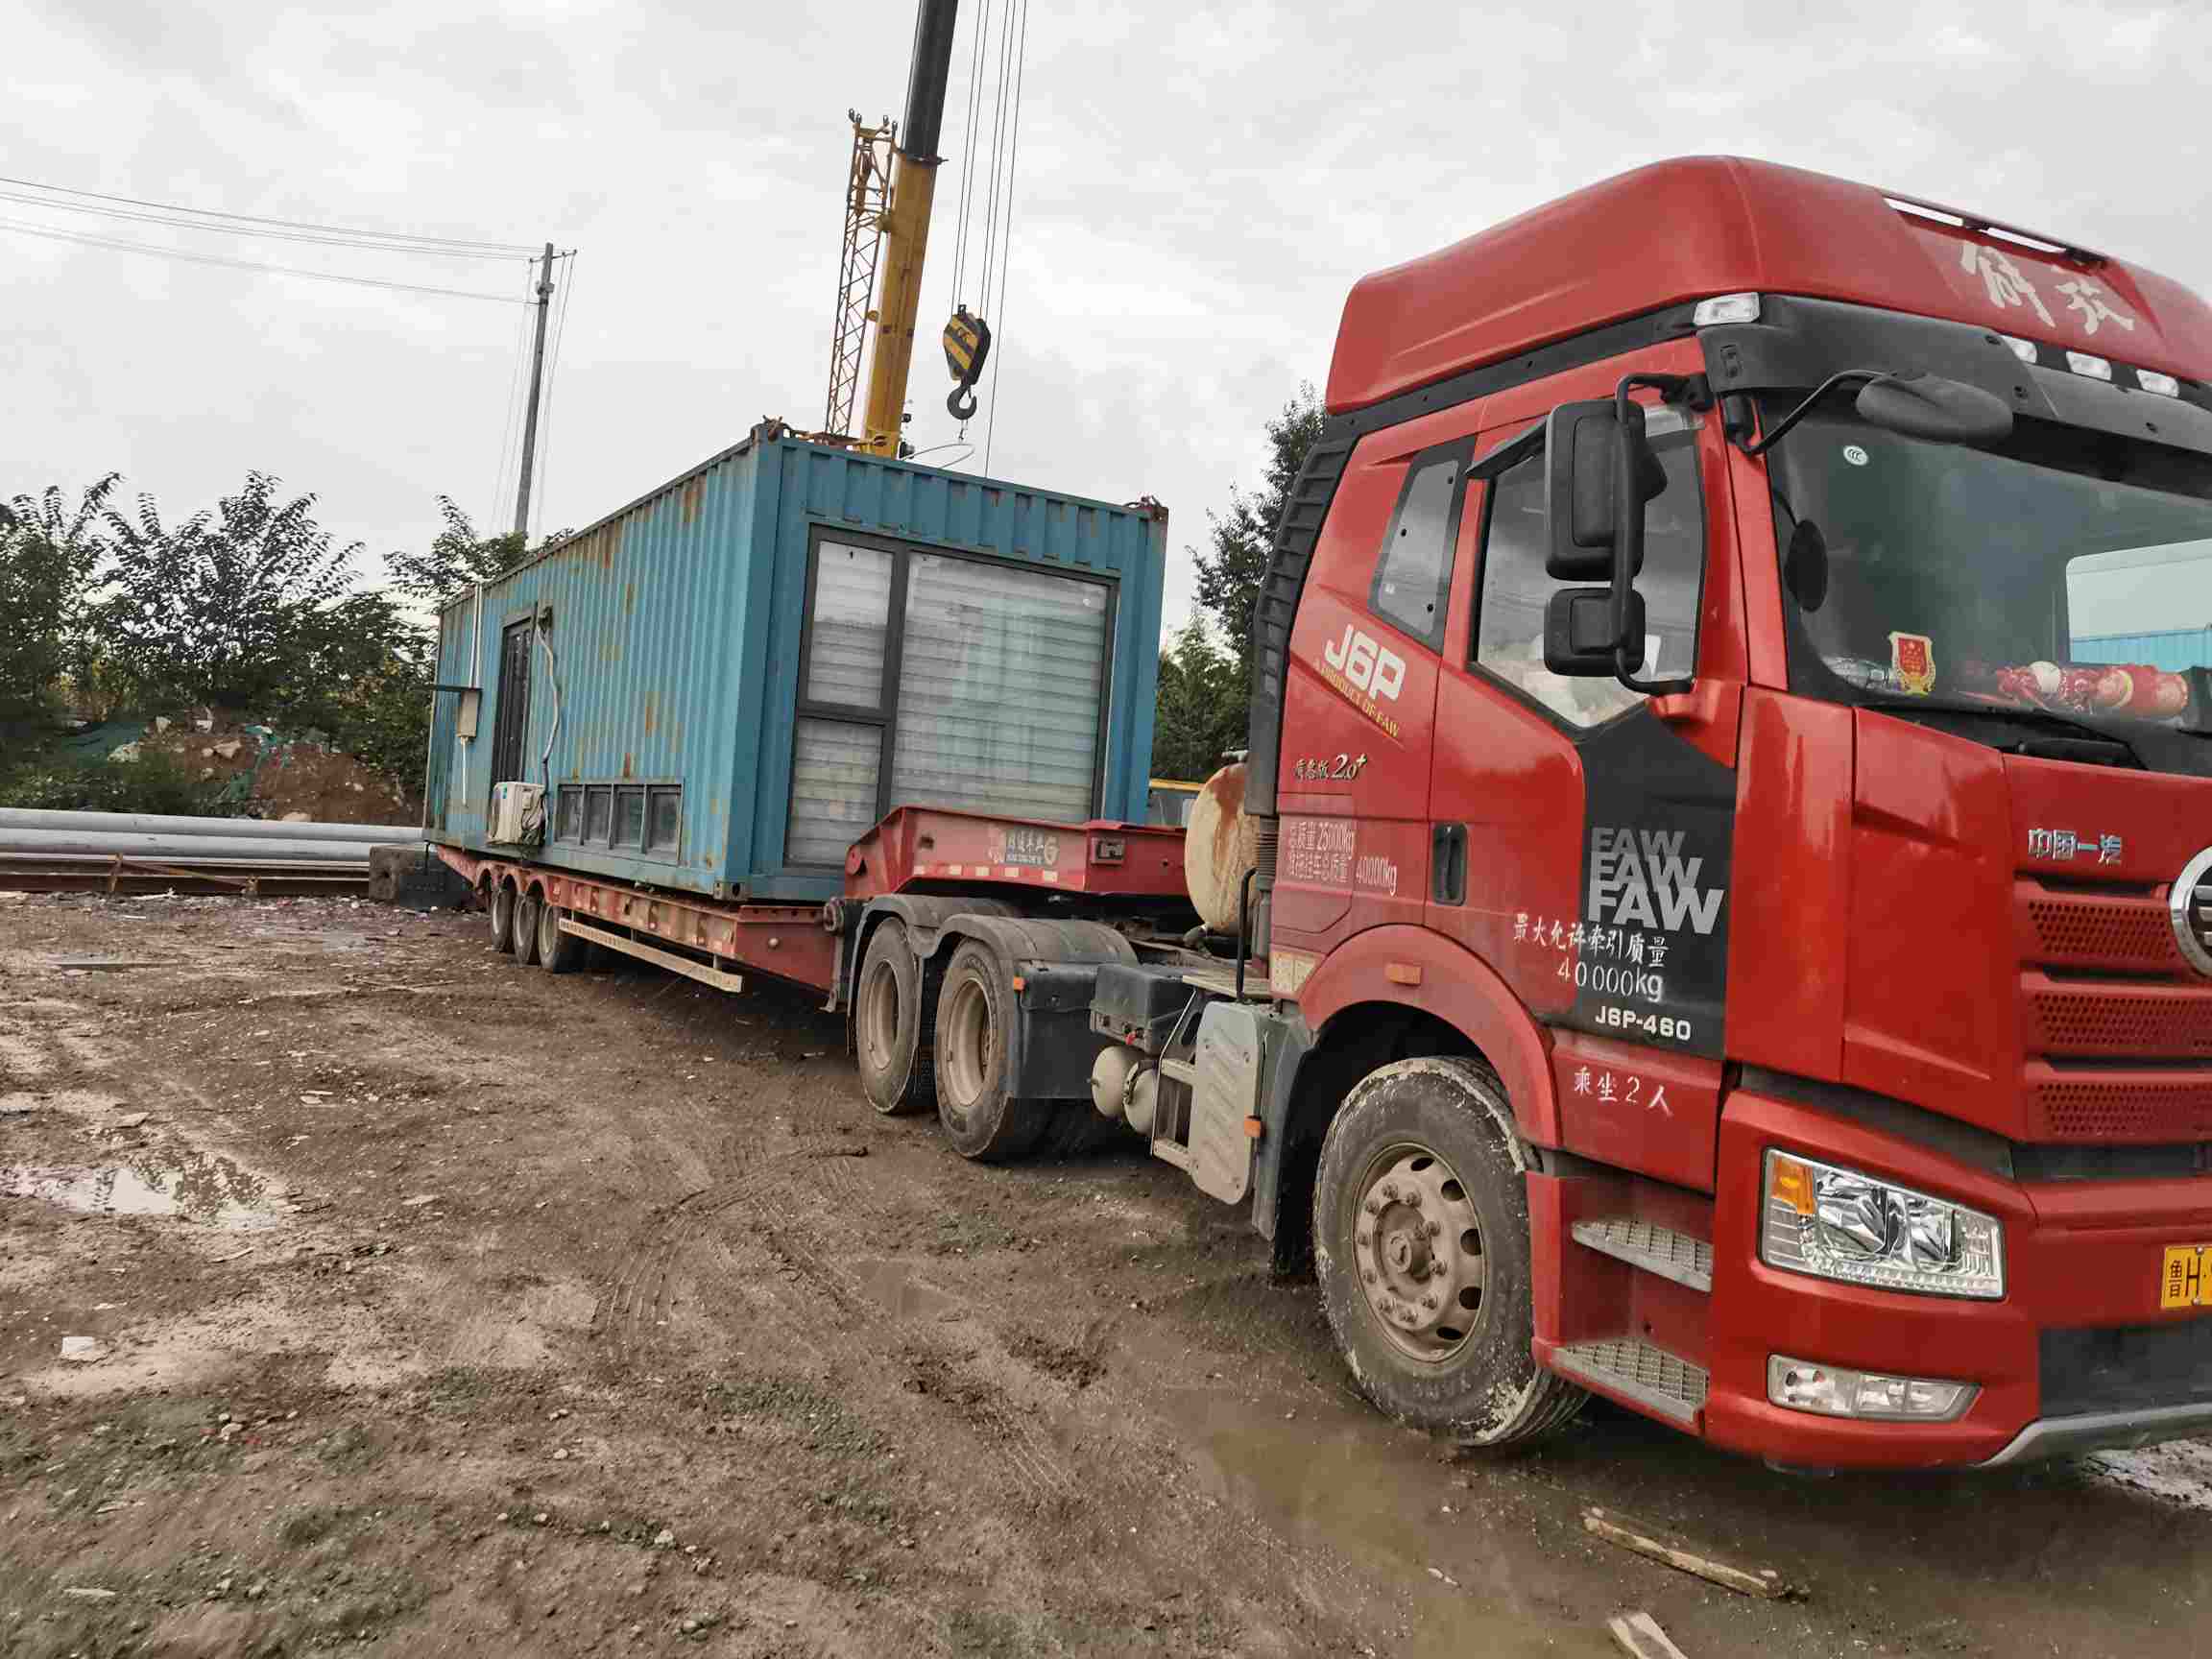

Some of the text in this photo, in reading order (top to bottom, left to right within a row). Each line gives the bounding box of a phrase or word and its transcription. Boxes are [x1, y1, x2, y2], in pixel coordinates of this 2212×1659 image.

[1325, 624, 1406, 702] J6P
[1588, 879, 1724, 935] FAW
[1513, 913, 1669, 968] 最大允许牵引质量
